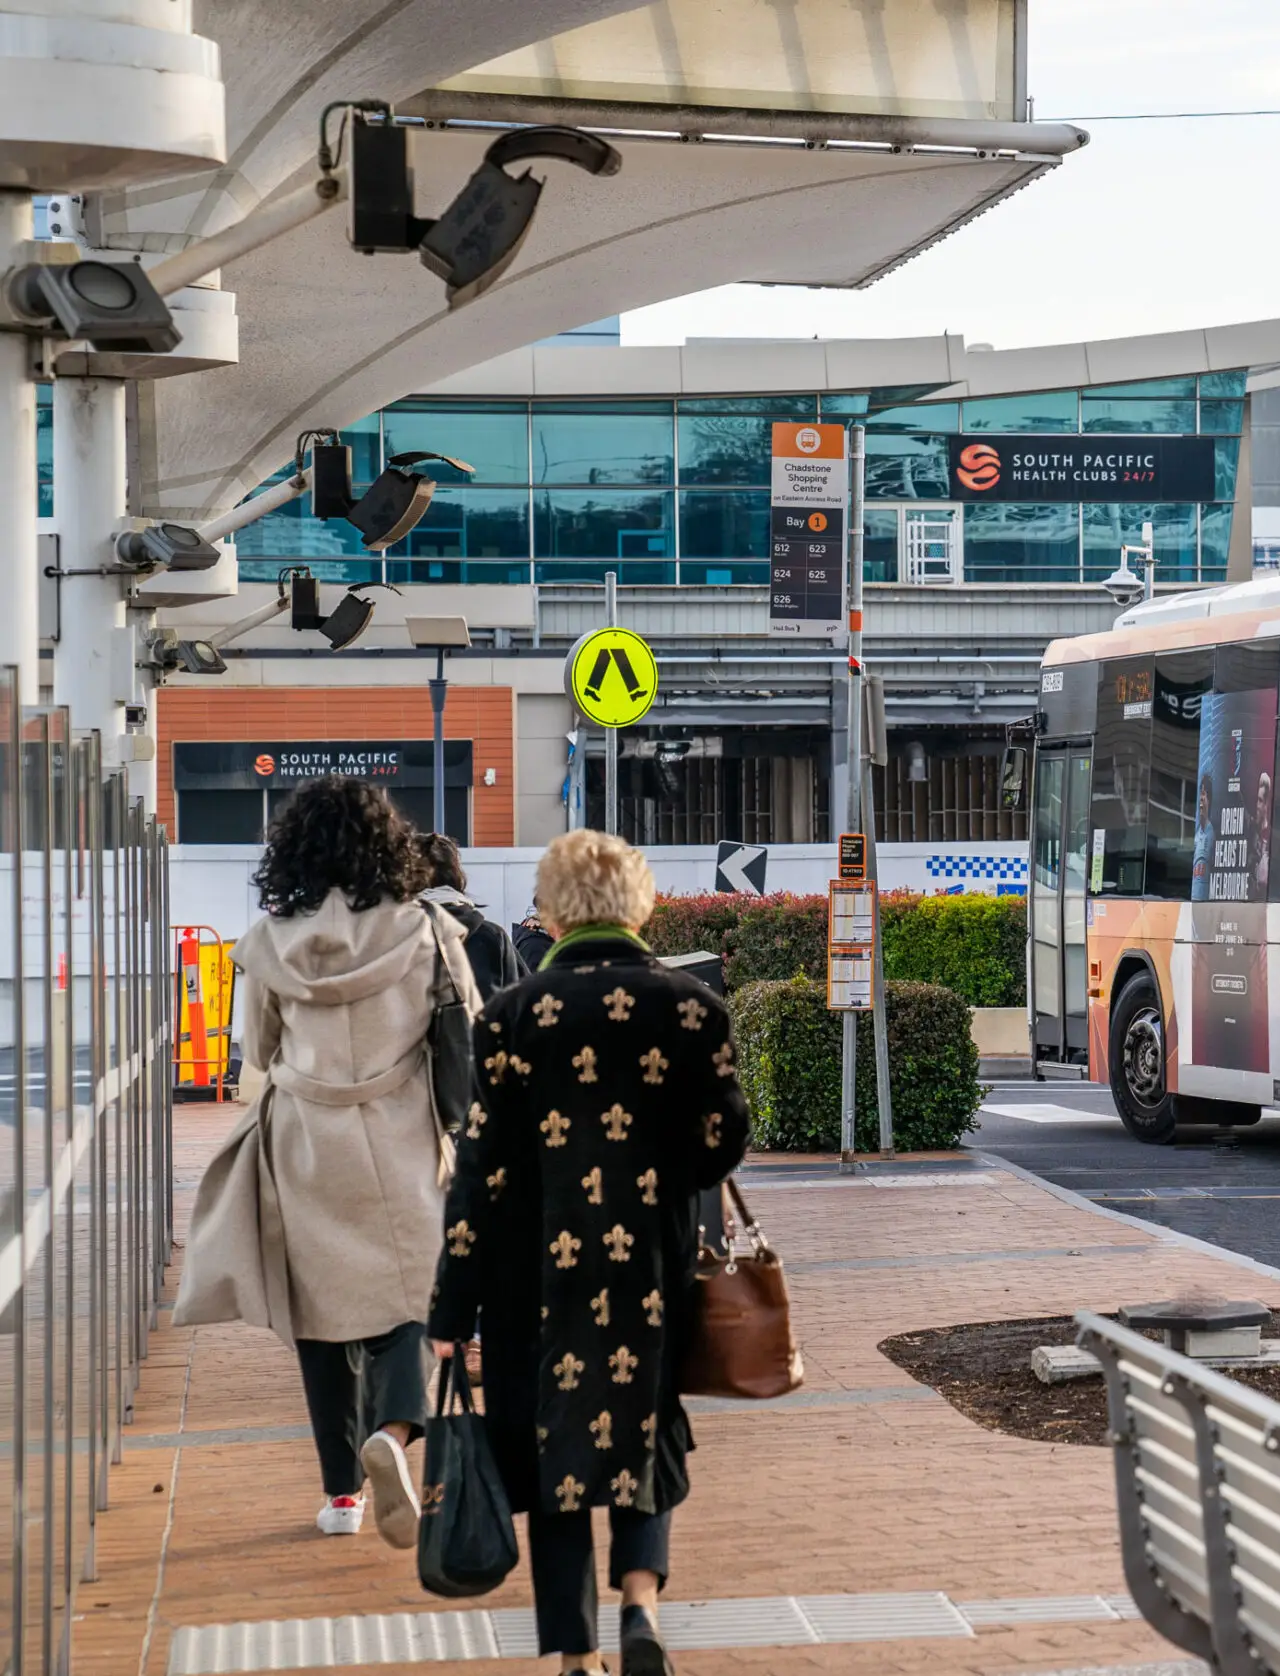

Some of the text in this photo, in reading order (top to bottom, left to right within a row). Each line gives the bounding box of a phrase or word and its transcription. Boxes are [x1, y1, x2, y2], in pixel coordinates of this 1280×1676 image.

[1013, 454, 1154, 468] SOUTH PACIFIC
[784, 463, 832, 473] Chadstone
[788, 473, 828, 484] Shopping
[1013, 471, 1155, 482] HEALTH CLUBS 24/7
[793, 484, 823, 492] Centre
[786, 517, 820, 528] Bay 1
[774, 544, 790, 552] 612
[809, 544, 826, 553] 623
[774, 569, 791, 578] 624
[808, 570, 826, 579] 625
[773, 595, 791, 604] 626
[280, 753, 397, 764] SOUTH PACIFIC
[280, 766, 399, 776] HEALTH CLUBS 24/7
[1220, 807, 1245, 835] ORIGIN
[1214, 839, 1248, 867] HEADS TO
[1208, 872, 1249, 900] MELBOURNE
